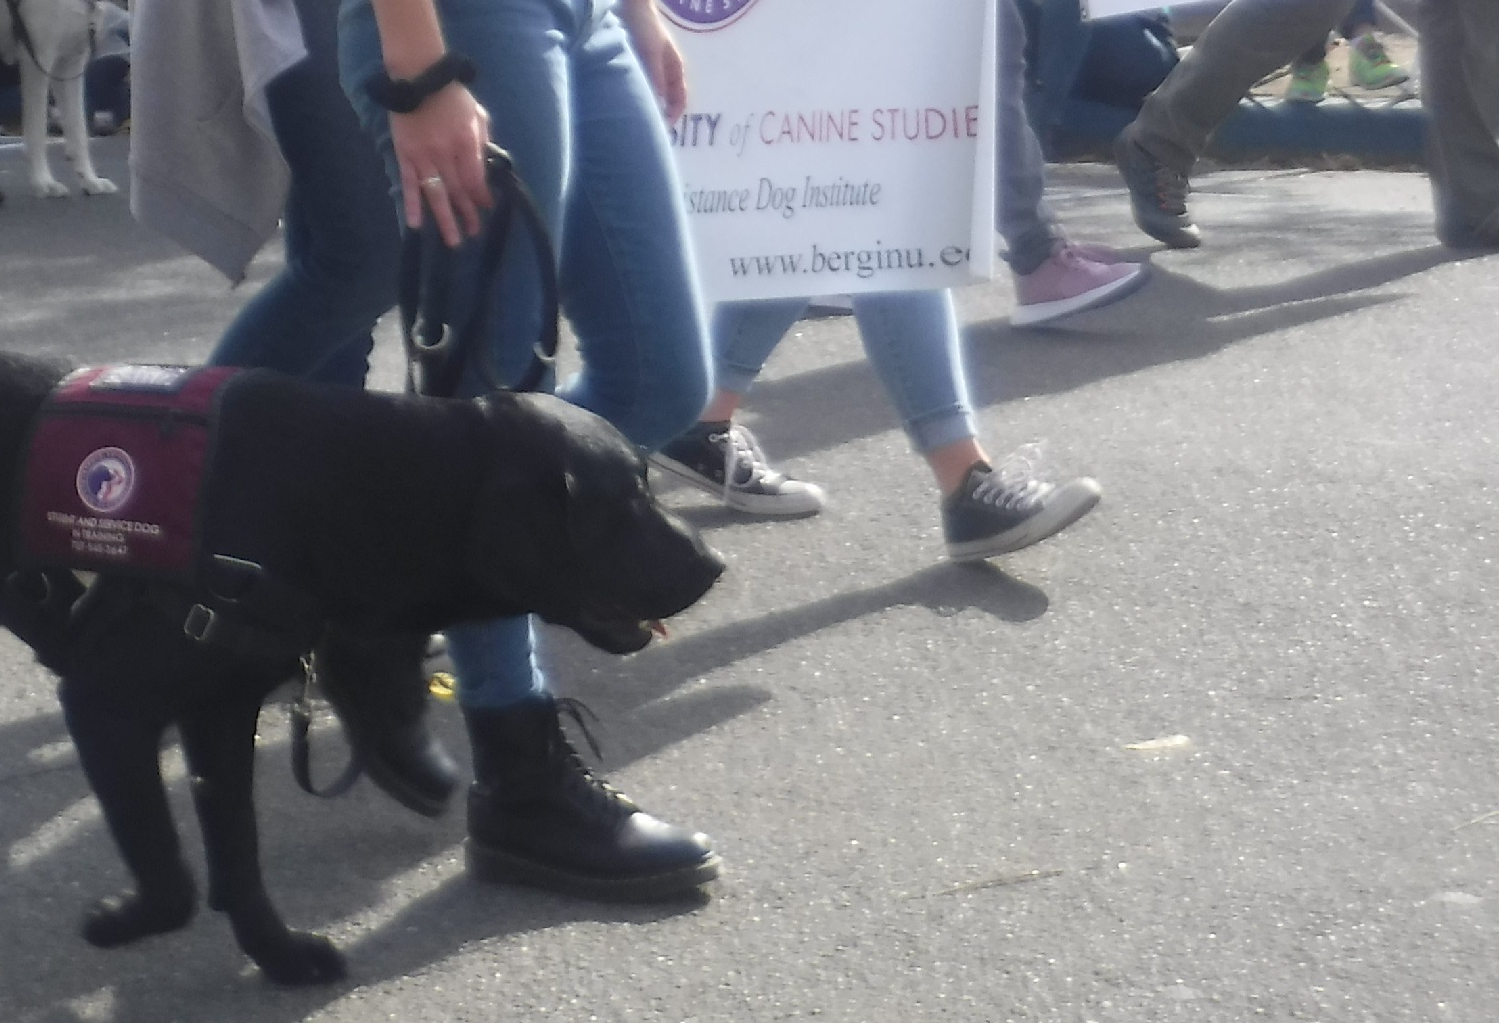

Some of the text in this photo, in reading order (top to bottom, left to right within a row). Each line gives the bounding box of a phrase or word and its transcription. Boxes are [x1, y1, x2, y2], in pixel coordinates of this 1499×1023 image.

[729, 113, 754, 157] of
[760, 110, 859, 144] CANINE
[871, 104, 978, 141] STUDIE
[756, 177, 797, 219] Dog
[802, 176, 881, 208] Institute
[77, 517, 98, 528] AND
[134, 521, 160, 535] DOG
